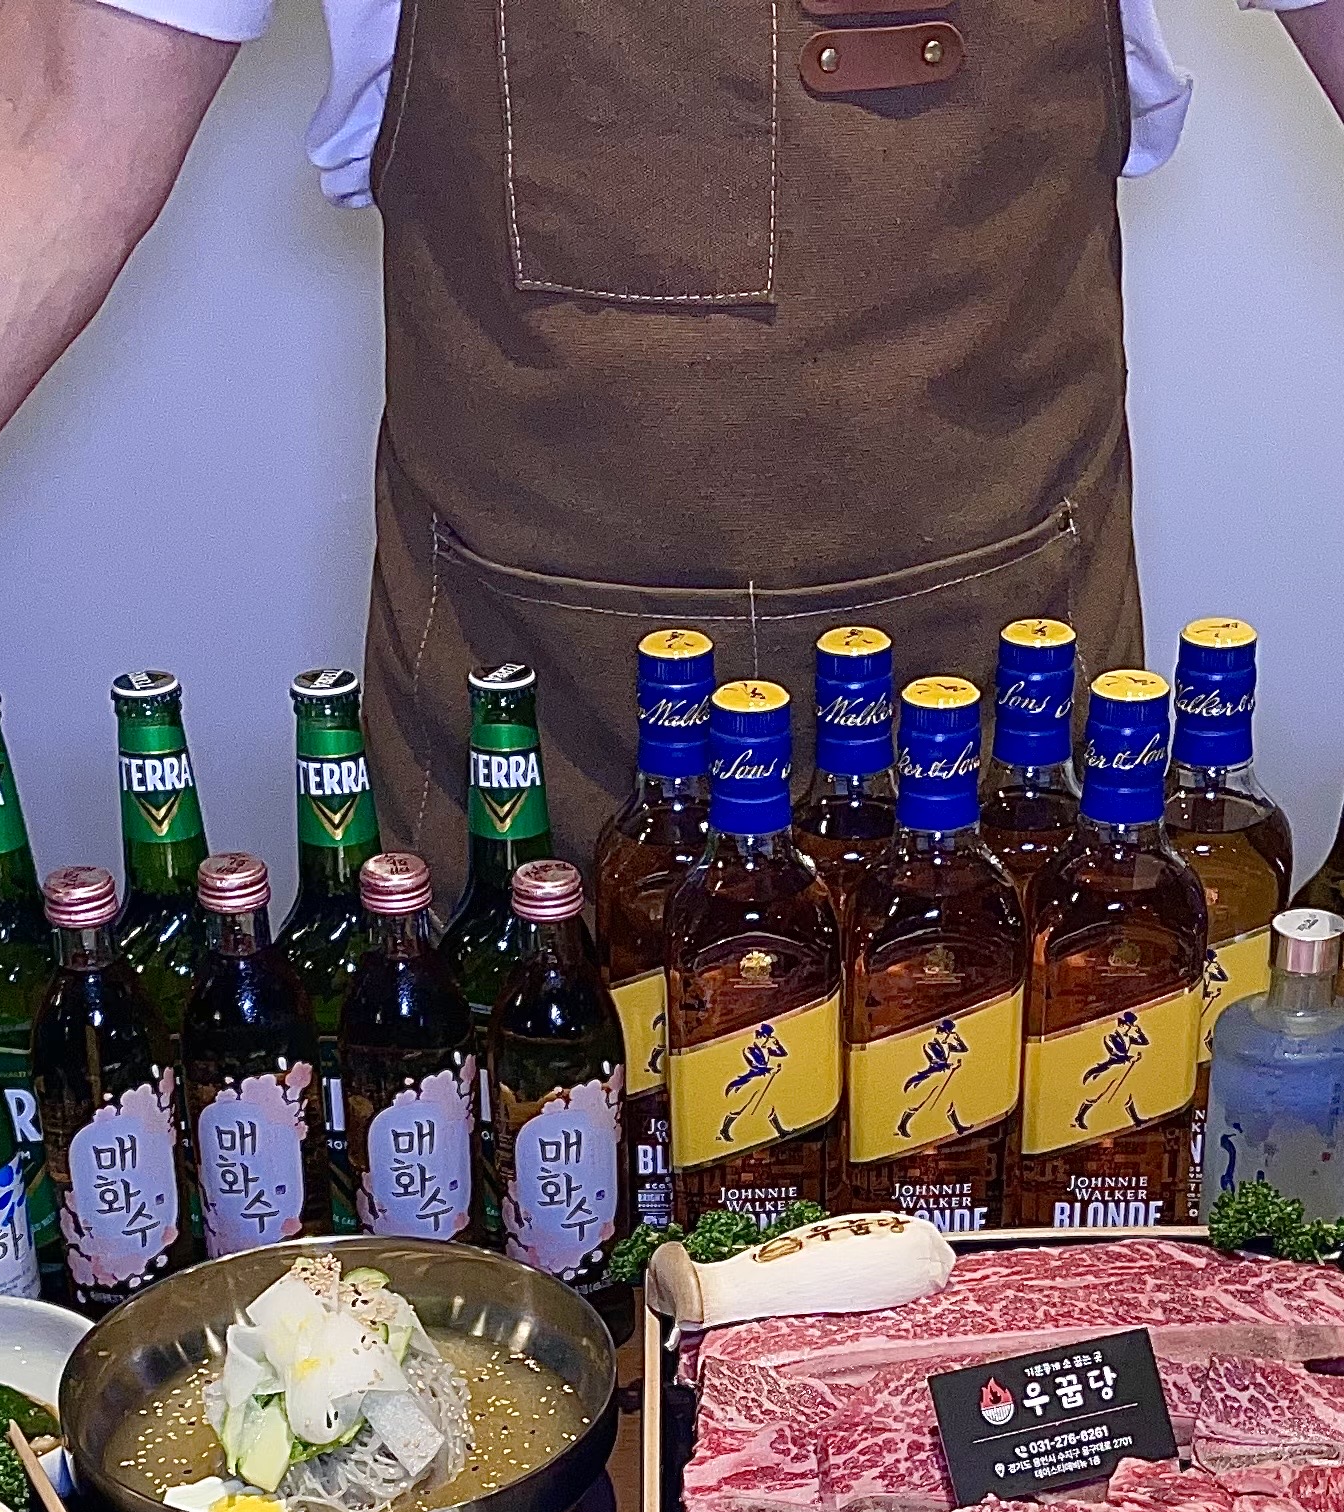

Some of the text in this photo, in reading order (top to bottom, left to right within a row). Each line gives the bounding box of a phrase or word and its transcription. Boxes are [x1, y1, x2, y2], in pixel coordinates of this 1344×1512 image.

[121, 754, 193, 792] TERRA
[297, 757, 371, 796] TERRA
[470, 752, 541, 788] TERRA
[92, 1134, 161, 1247] 매화수
[215, 1120, 280, 1234] 매화수
[390, 1119, 454, 1232] 매화수
[537, 1129, 599, 1242] 매화수
[891, 1183, 972, 1199] JOHNNIE
[1066, 1175, 1149, 1192] JOHNNIE
[718, 1187, 798, 1203] JOHNNIE
[725, 1200, 787, 1213] WALKE
[900, 1196, 972, 1209] WALKER
[1074, 1188, 1148, 1201] WALKER
[1022, 1365, 1118, 1417] 우꿉당
